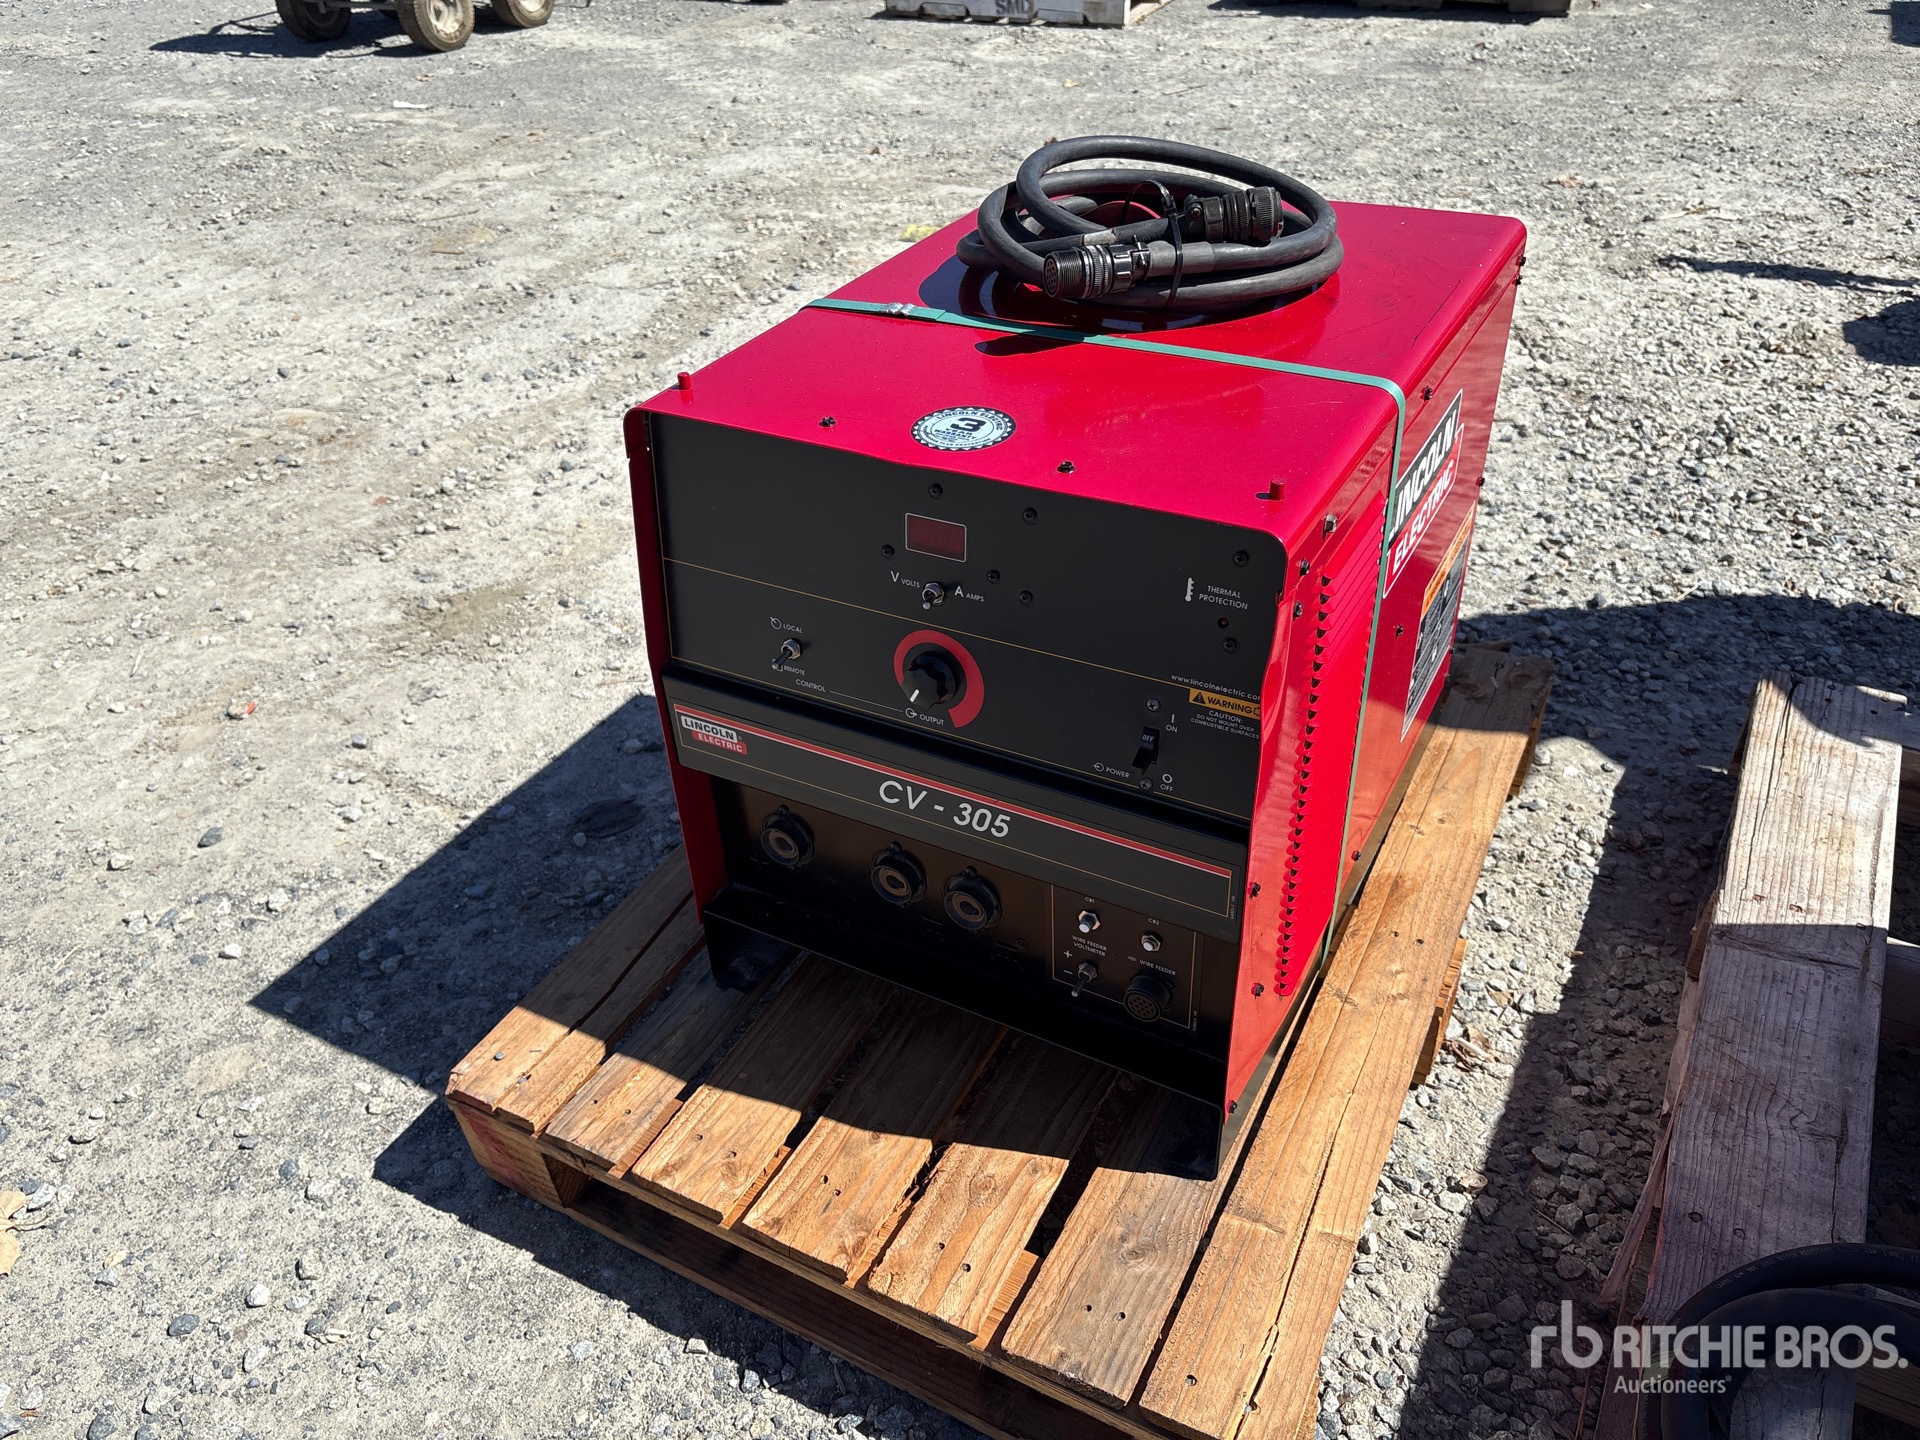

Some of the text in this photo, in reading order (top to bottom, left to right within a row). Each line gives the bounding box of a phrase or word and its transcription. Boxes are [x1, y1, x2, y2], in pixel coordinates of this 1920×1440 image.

[950, 417, 987, 432] 3
[1392, 458, 1455, 576] ELECTRIC
[901, 577, 920, 588] VOLTS
[965, 592, 985, 602] AMPS
[1207, 585, 1241, 599] THERMAL
[1199, 593, 1248, 610] PROTECTION
[783, 623, 803, 634] LOCAL
[783, 665, 805, 676] REMOTE
[795, 678, 826, 693] CONTROL
[1207, 696, 1253, 714] WARNING
[919, 713, 945, 726] OUTPUT
[1218, 719, 1238, 728] MOUNT
[1238, 724, 1255, 733] OVER
[684, 718, 735, 741] LINCOLN
[1165, 724, 1178, 733] ON
[1191, 718, 1260, 740] COMBUSTIBLE SURFACES
[697, 733, 743, 753] ELECTRIC
[1141, 734, 1155, 742] OFF
[1105, 766, 1130, 779] POWER
[1160, 783, 1174, 792] OFF
[879, 780, 928, 810] CV
[953, 802, 1012, 838] 305
[1072, 935, 1107, 951] WIRE FEEDER
[1073, 942, 1106, 957] VOLTMETER
[1139, 959, 1176, 976] WIRE FEEDER
